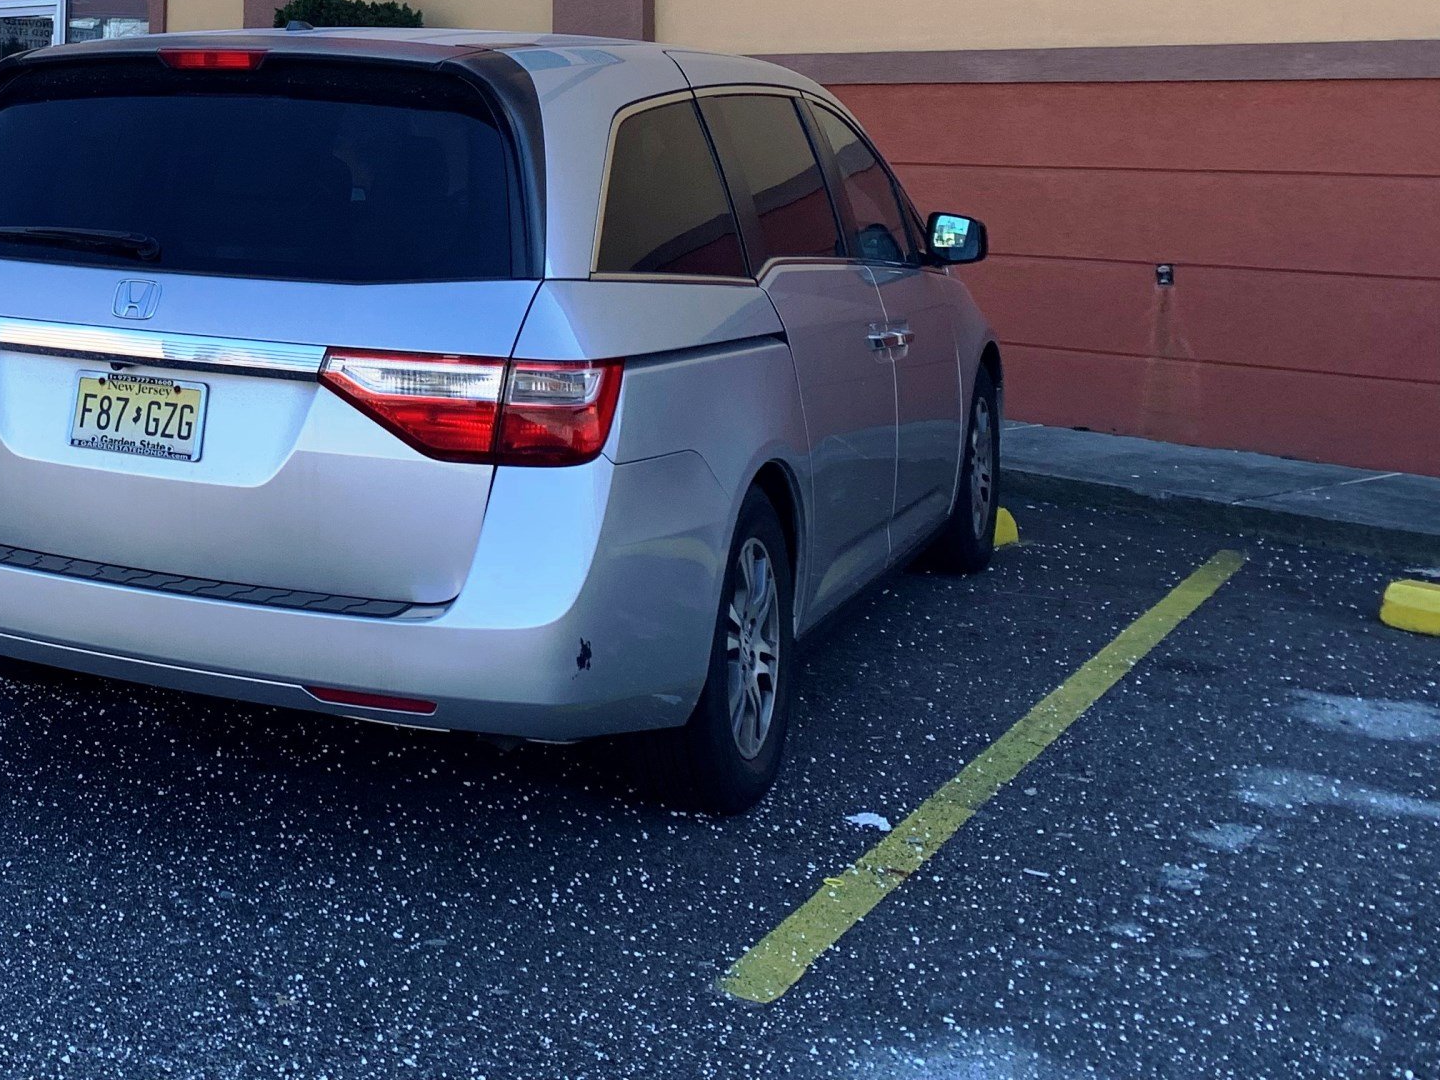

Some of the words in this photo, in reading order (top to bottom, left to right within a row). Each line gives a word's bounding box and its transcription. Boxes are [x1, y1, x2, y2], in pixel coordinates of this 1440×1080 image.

[108, 380, 136, 392] New
[136, 383, 172, 399] Jersey
[80, 393, 130, 432] F87
[145, 400, 194, 441] GZG
[100, 435, 136, 447] Garden
[140, 440, 166, 450] State
